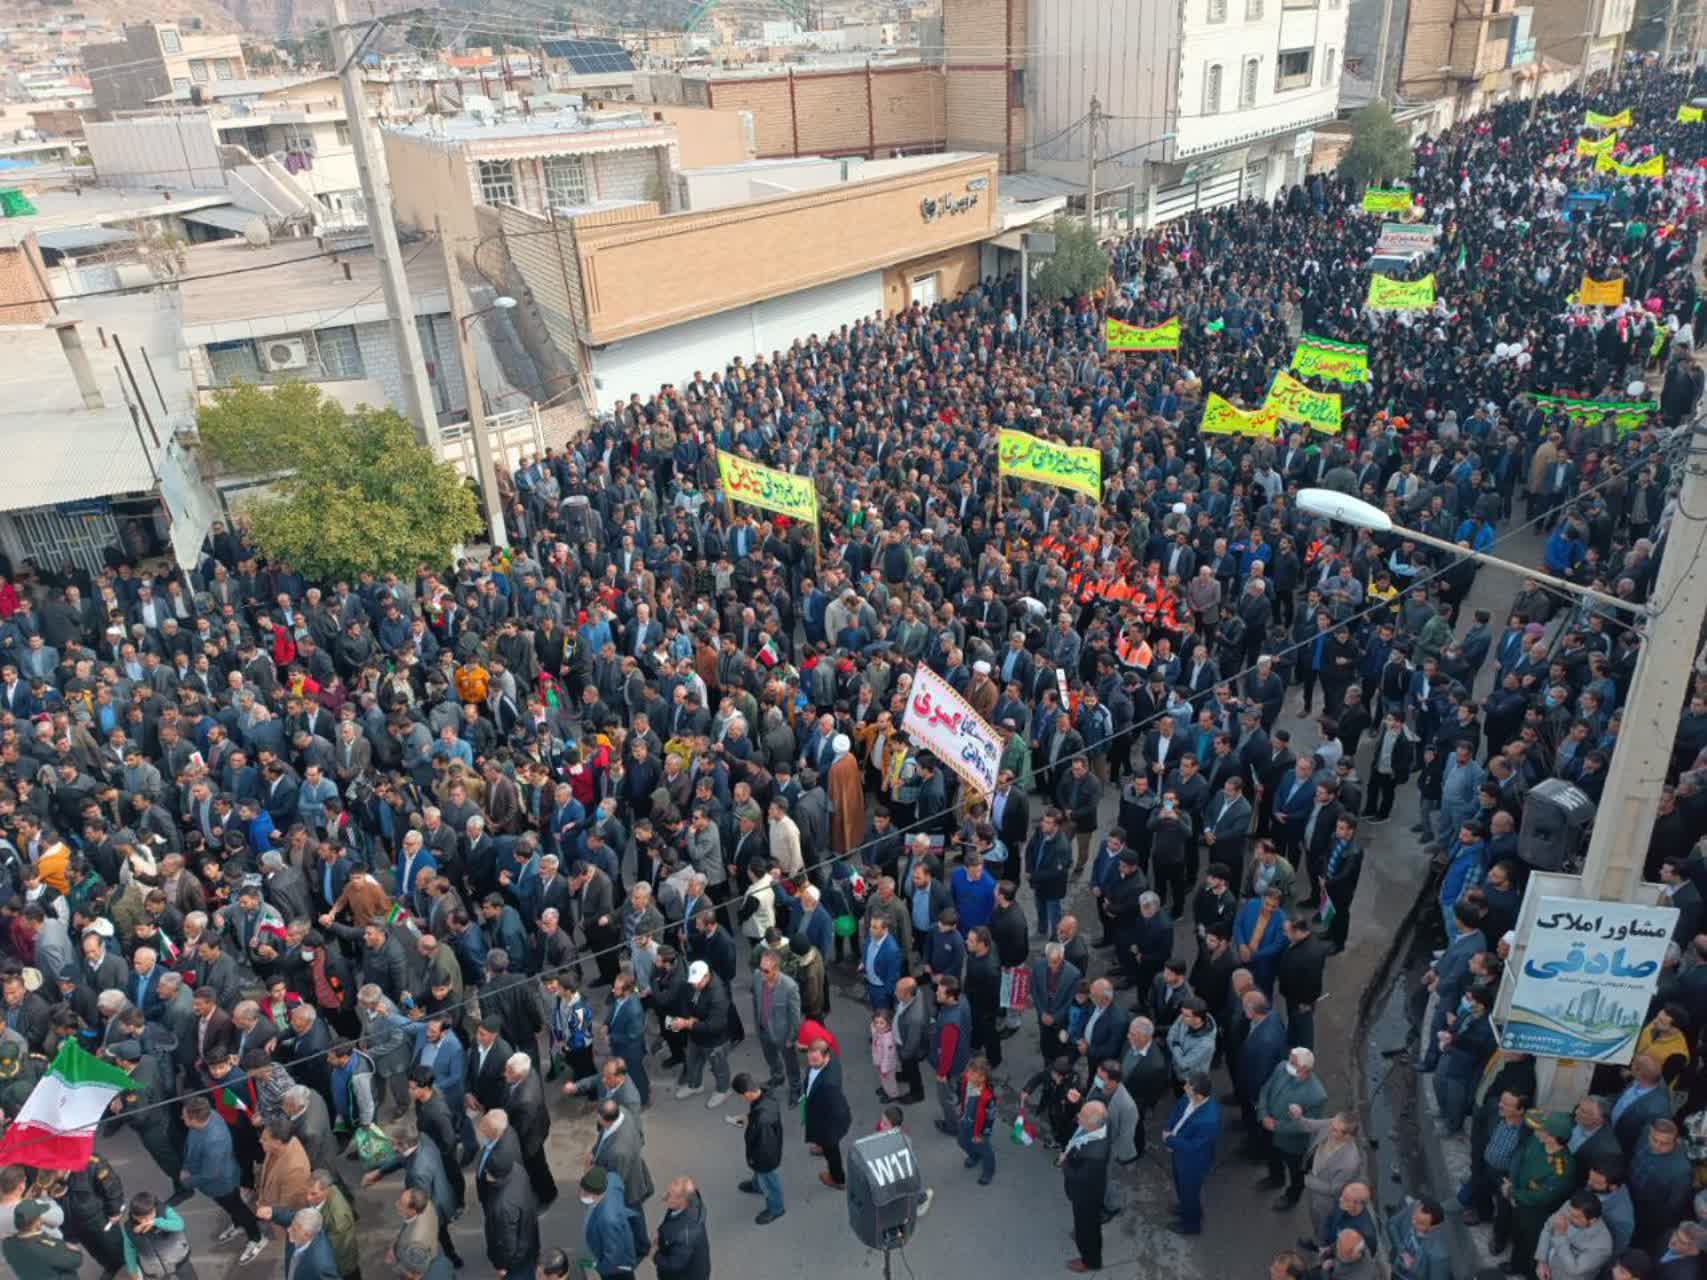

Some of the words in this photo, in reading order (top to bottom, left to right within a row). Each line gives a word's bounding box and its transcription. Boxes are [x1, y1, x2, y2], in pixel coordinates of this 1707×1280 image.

[1536, 911, 1603, 934] املاک
[1600, 918, 1667, 941] مشاور
[1523, 941, 1659, 979] صادقی
[866, 1148, 914, 1187] W17
